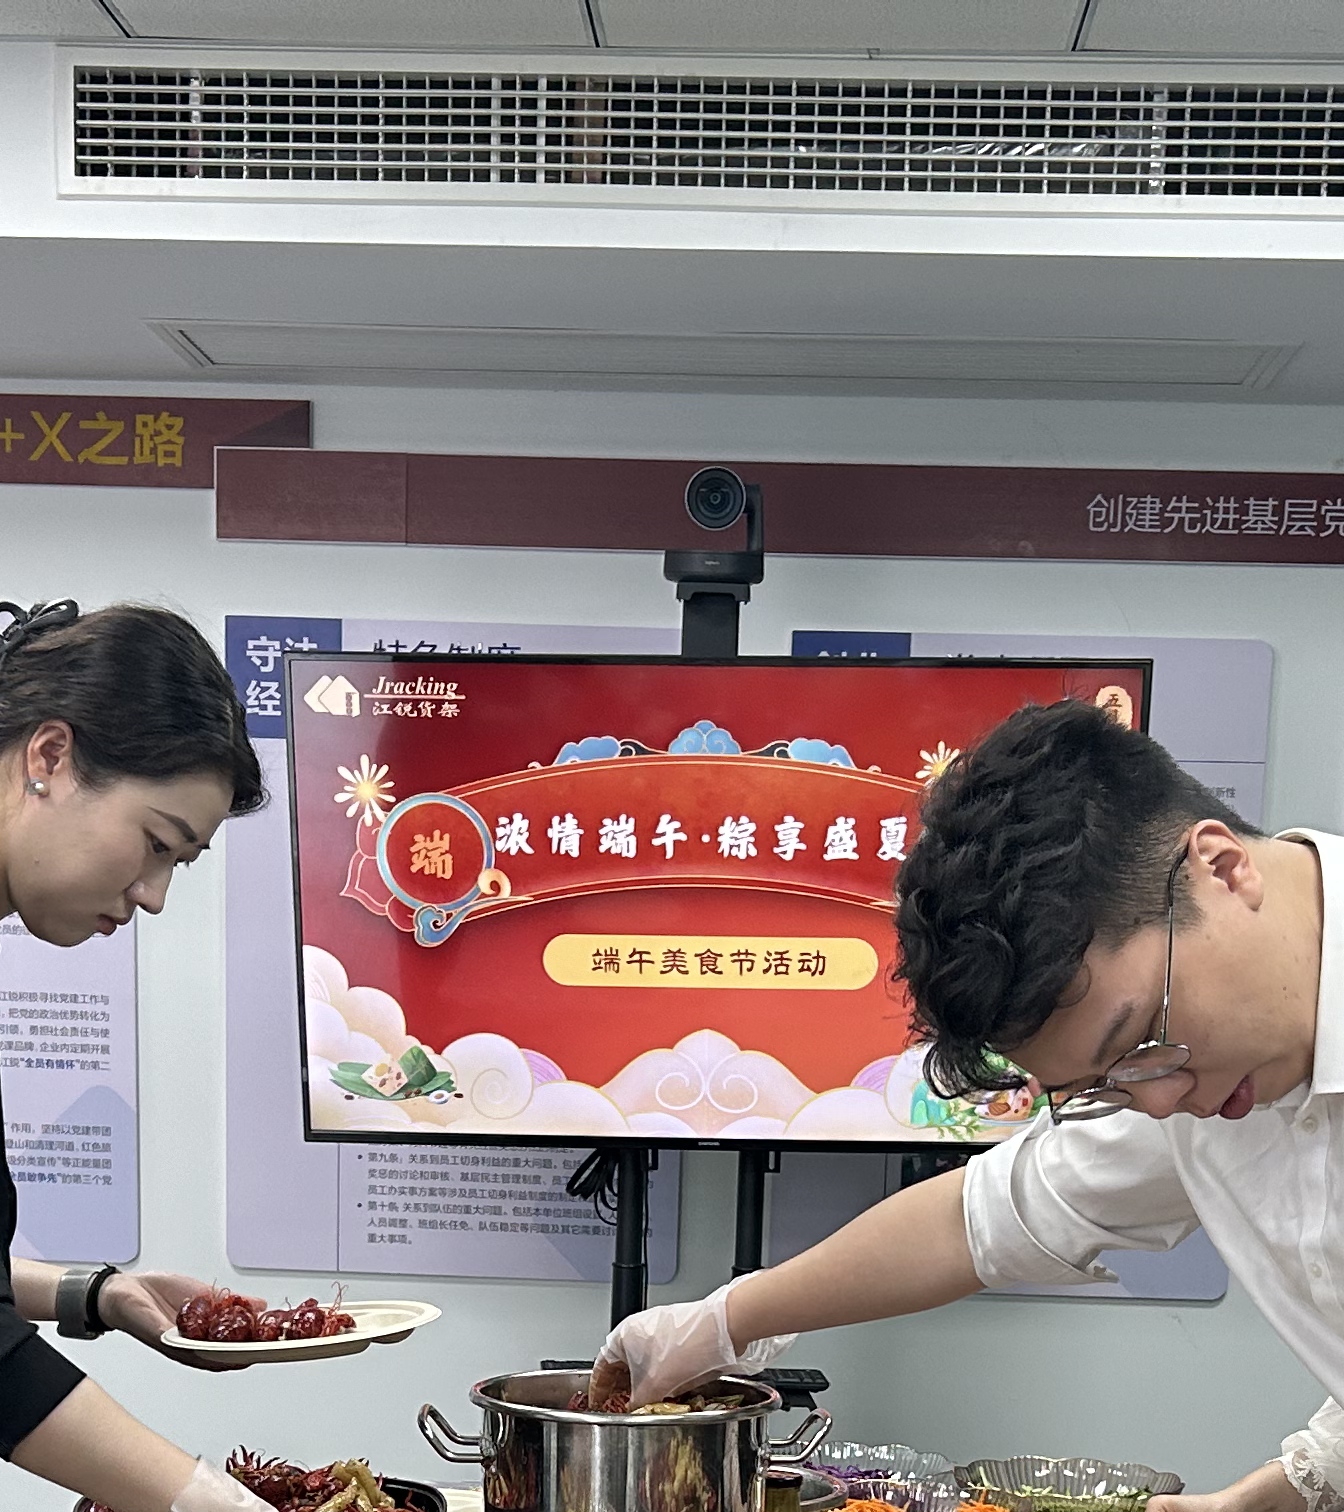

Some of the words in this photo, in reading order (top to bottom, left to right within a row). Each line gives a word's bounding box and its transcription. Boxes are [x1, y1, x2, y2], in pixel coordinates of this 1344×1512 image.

[372, 675, 459, 699] Jracking
[372, 701, 461, 718] 江锐货架
[409, 829, 454, 879] 端
[591, 946, 828, 978] 端午美食节活动
